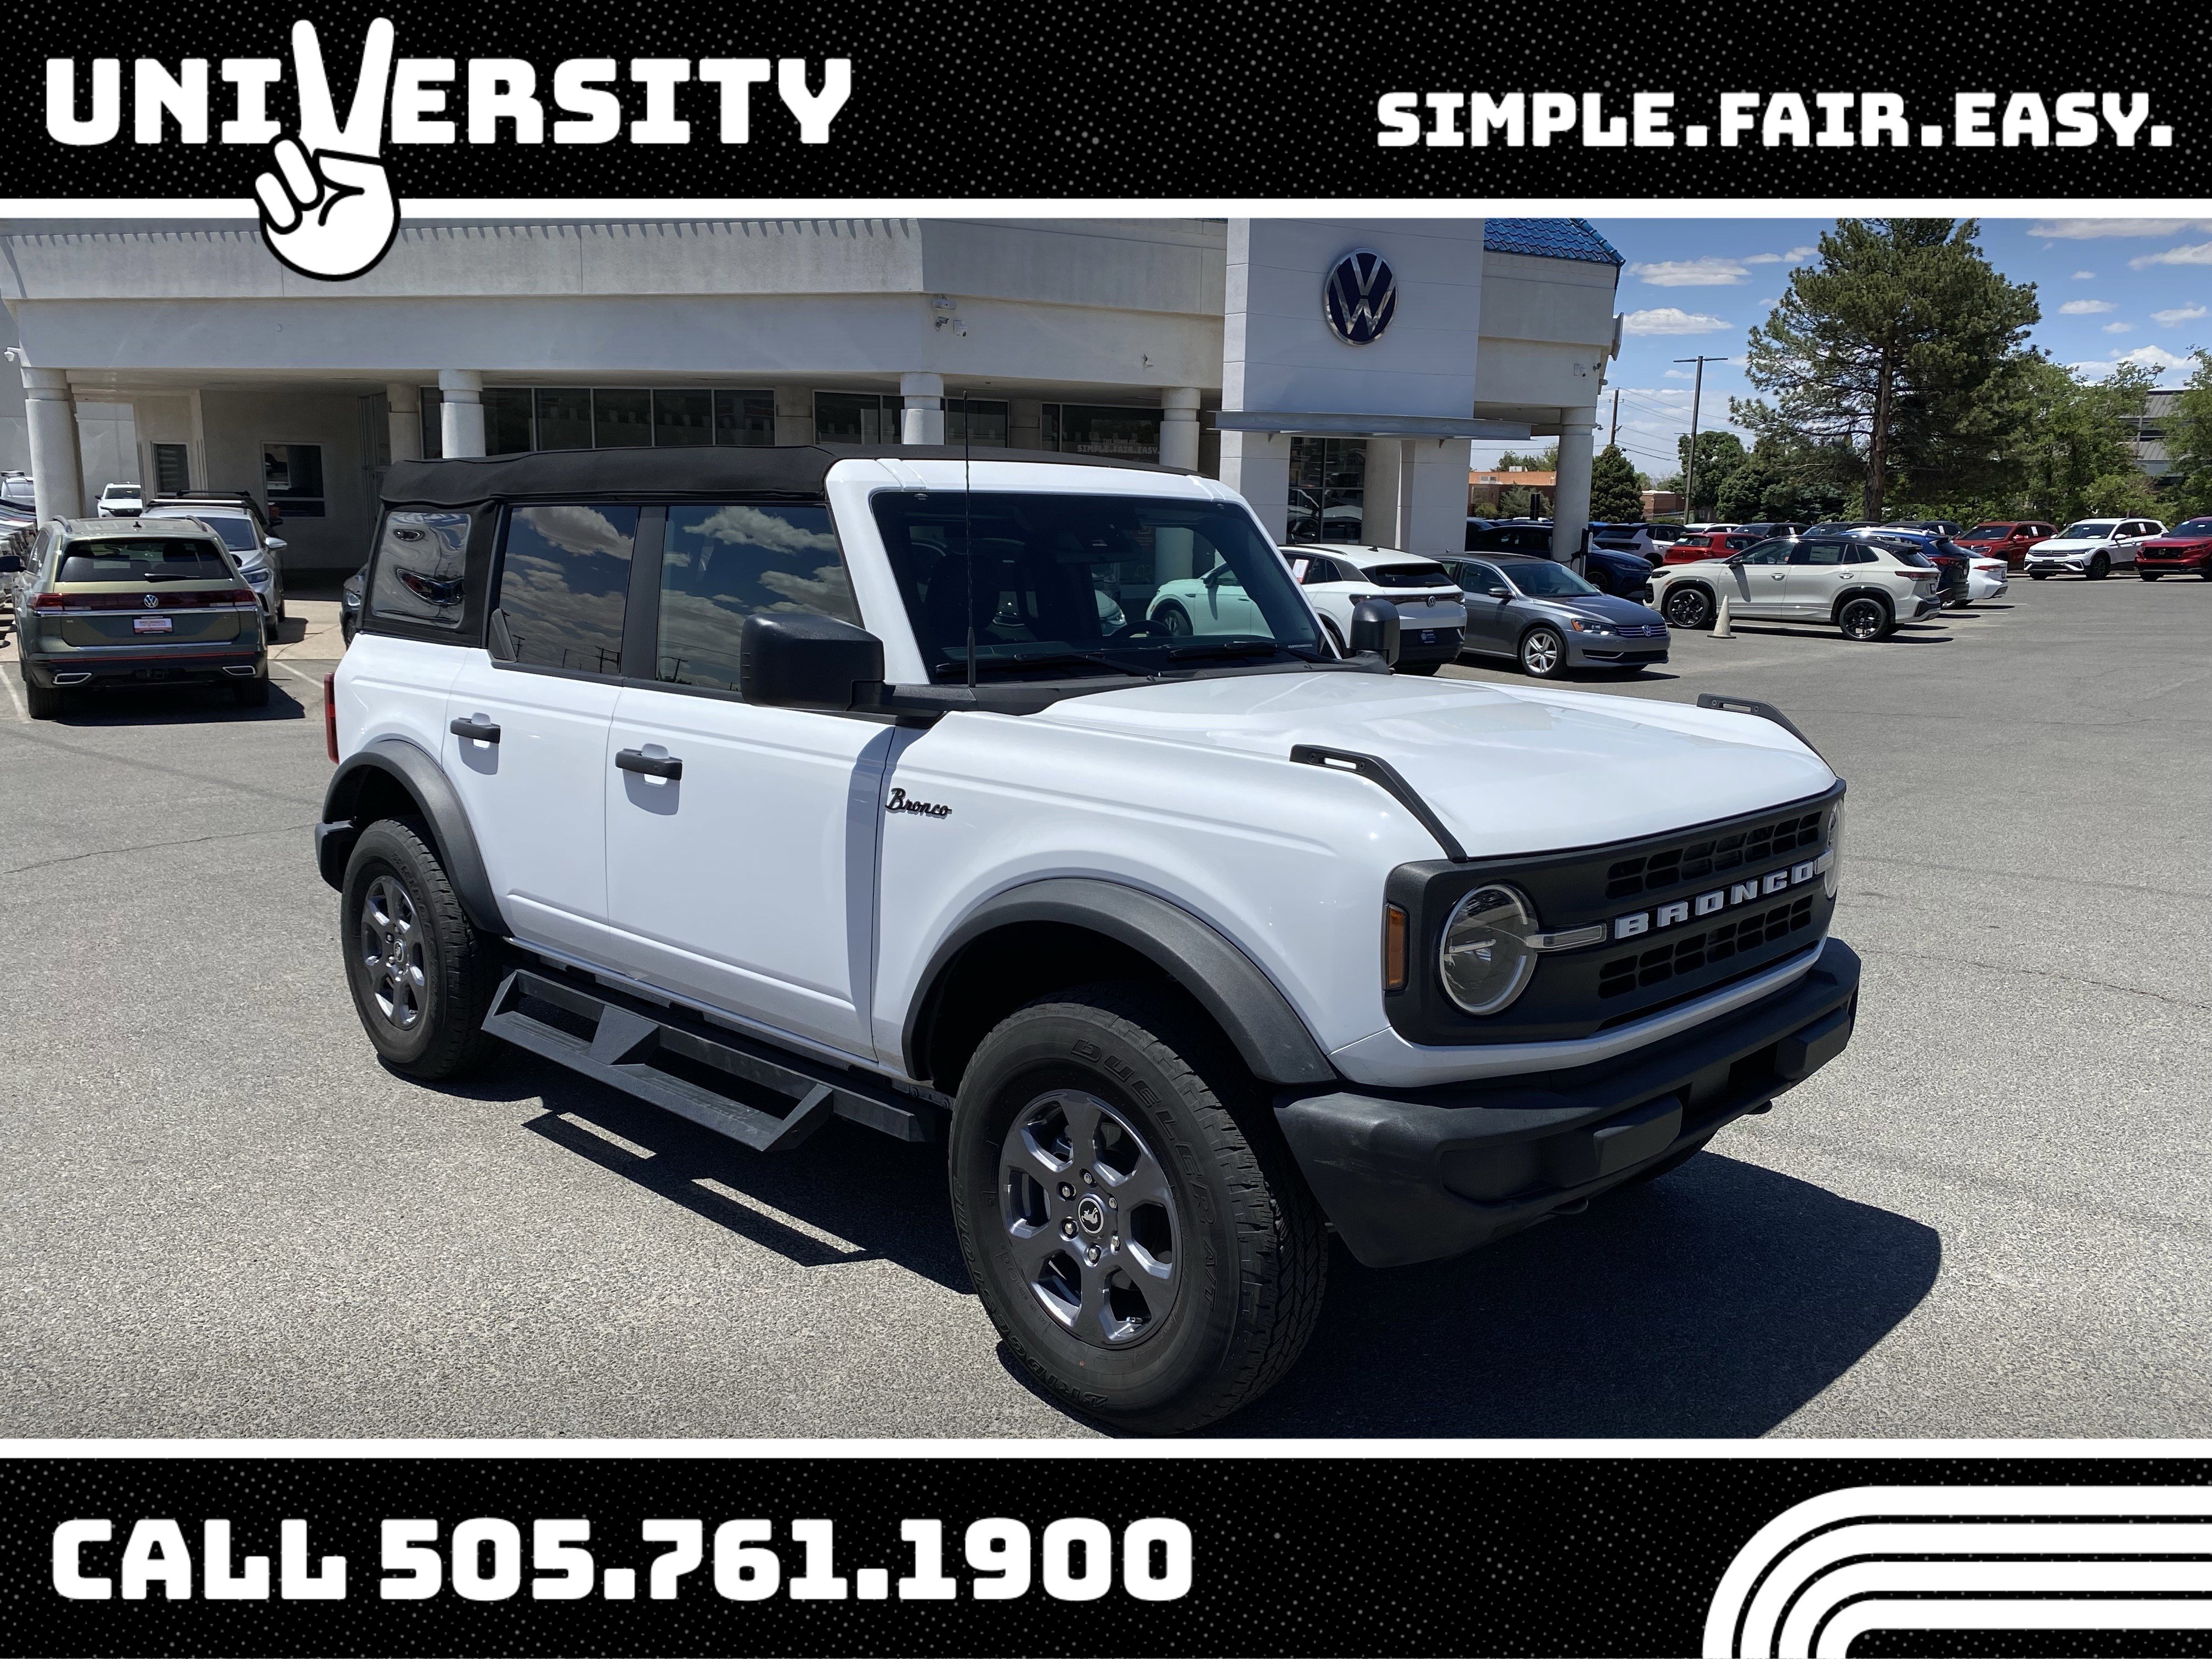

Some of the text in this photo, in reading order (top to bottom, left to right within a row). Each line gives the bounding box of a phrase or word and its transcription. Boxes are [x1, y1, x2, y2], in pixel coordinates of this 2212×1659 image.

[1323, 248, 1398, 346] VW
[885, 788, 952, 819] Bronco
[1615, 861, 1813, 939] BRONCO
[1071, 1038, 1217, 1226] DUELER
[953, 1175, 1109, 1410] BRIDGESTONE
